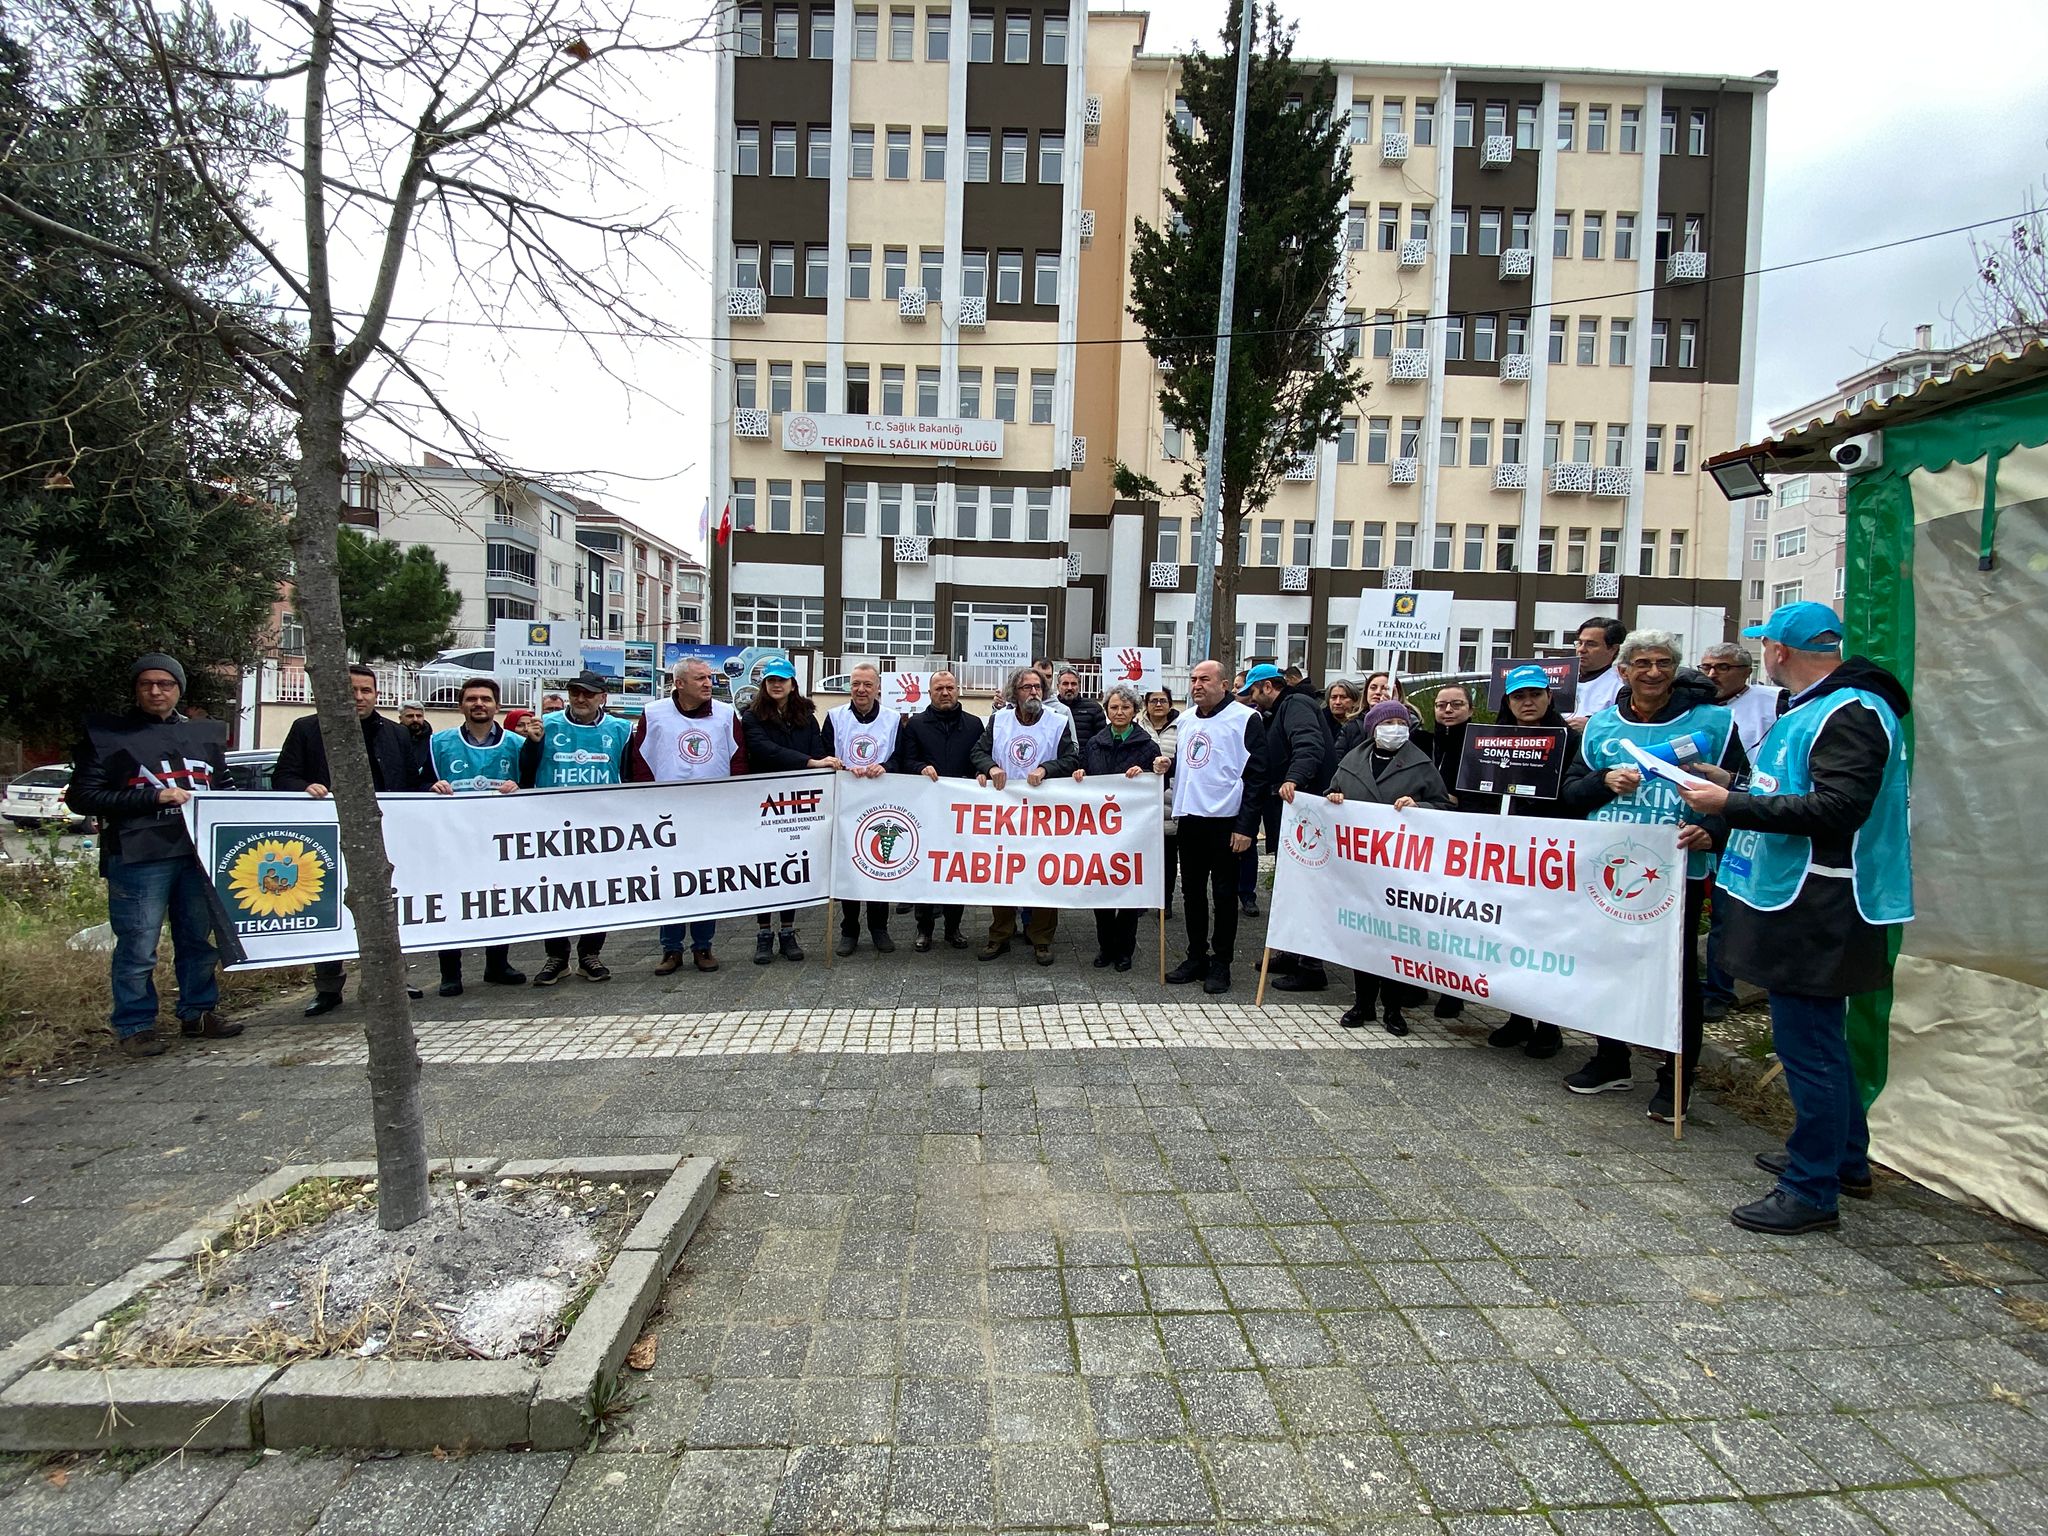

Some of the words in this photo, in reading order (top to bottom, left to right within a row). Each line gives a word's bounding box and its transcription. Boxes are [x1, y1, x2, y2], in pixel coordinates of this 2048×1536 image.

[866, 421, 884, 431] T.C.
[886, 422, 916, 434] Sağlık
[919, 423, 963, 435] Bakanlığı
[821, 435, 874, 448] TEKİRDAĞ
[877, 437, 887, 448] İL
[889, 437, 927, 450] SAĞLIK
[931, 438, 997, 452] MÜDÜRLÜĞÜ
[1360, 629, 1383, 638] AİLE
[1385, 630, 1441, 640] HEKİMLERİ
[1377, 620, 1427, 630] TEKİRDAĞ
[515, 649, 562, 658] TEKİRDAĞ
[1377, 640, 1420, 649] DERNEĞİ
[500, 657, 523, 666] AİLE
[524, 658, 575, 667] HEKİMLERİ
[518, 667, 559, 676] DERNEĞİ
[1477, 738, 1513, 747] HEKİME
[1514, 738, 1547, 748] ŞİDDET
[1484, 748, 1510, 758] SONA
[553, 765, 610, 784] HEKİM
[760, 789, 824, 817] AHEF
[760, 818, 772, 826] AİLE
[771, 817, 797, 826] HEKİMLERİ
[797, 815, 826, 824] DERNEKLERİ
[855, 803, 888, 824] TEKİRDAĞ
[889, 803, 908, 815] TABİP
[906, 811, 923, 830] ODASI
[951, 794, 1122, 836] TEKİRDAĞ
[492, 813, 677, 861] TEKİRDAĞ
[778, 825, 811, 834] FEDERASYONU
[217, 840, 247, 874] TEKİRDAĞ
[246, 832, 266, 844] AİLE
[267, 829, 315, 845] HEKİMLERİ
[312, 841, 336, 871] DERNEĞİ
[1335, 823, 1435, 873] HEKİM
[1444, 832, 1576, 892] BİRLİĞİ
[856, 856, 869, 872] TÜRK
[868, 866, 897, 878] TABİPLERİ
[897, 858, 916, 875] BİRLİĞİ
[927, 845, 1027, 885] TABİP
[1037, 852, 1143, 886] ODASI
[390, 887, 447, 926] İLE
[461, 865, 661, 921] HEKİMLERİ
[673, 850, 811, 899] DERNEĞİ
[1385, 887, 1503, 925] SENDİKASI
[1587, 885, 1606, 907] HEKİM
[1605, 905, 1637, 921] BİRLİĞİ
[1637, 894, 1676, 921] SENDİKASI
[234, 916, 319, 933] TEKAHED
[1337, 907, 1422, 947] HEKİMLER
[1427, 928, 1503, 964] BİRLİK
[1509, 946, 1576, 977] OLDU
[1390, 955, 1490, 998] TEKİRDAĞ
